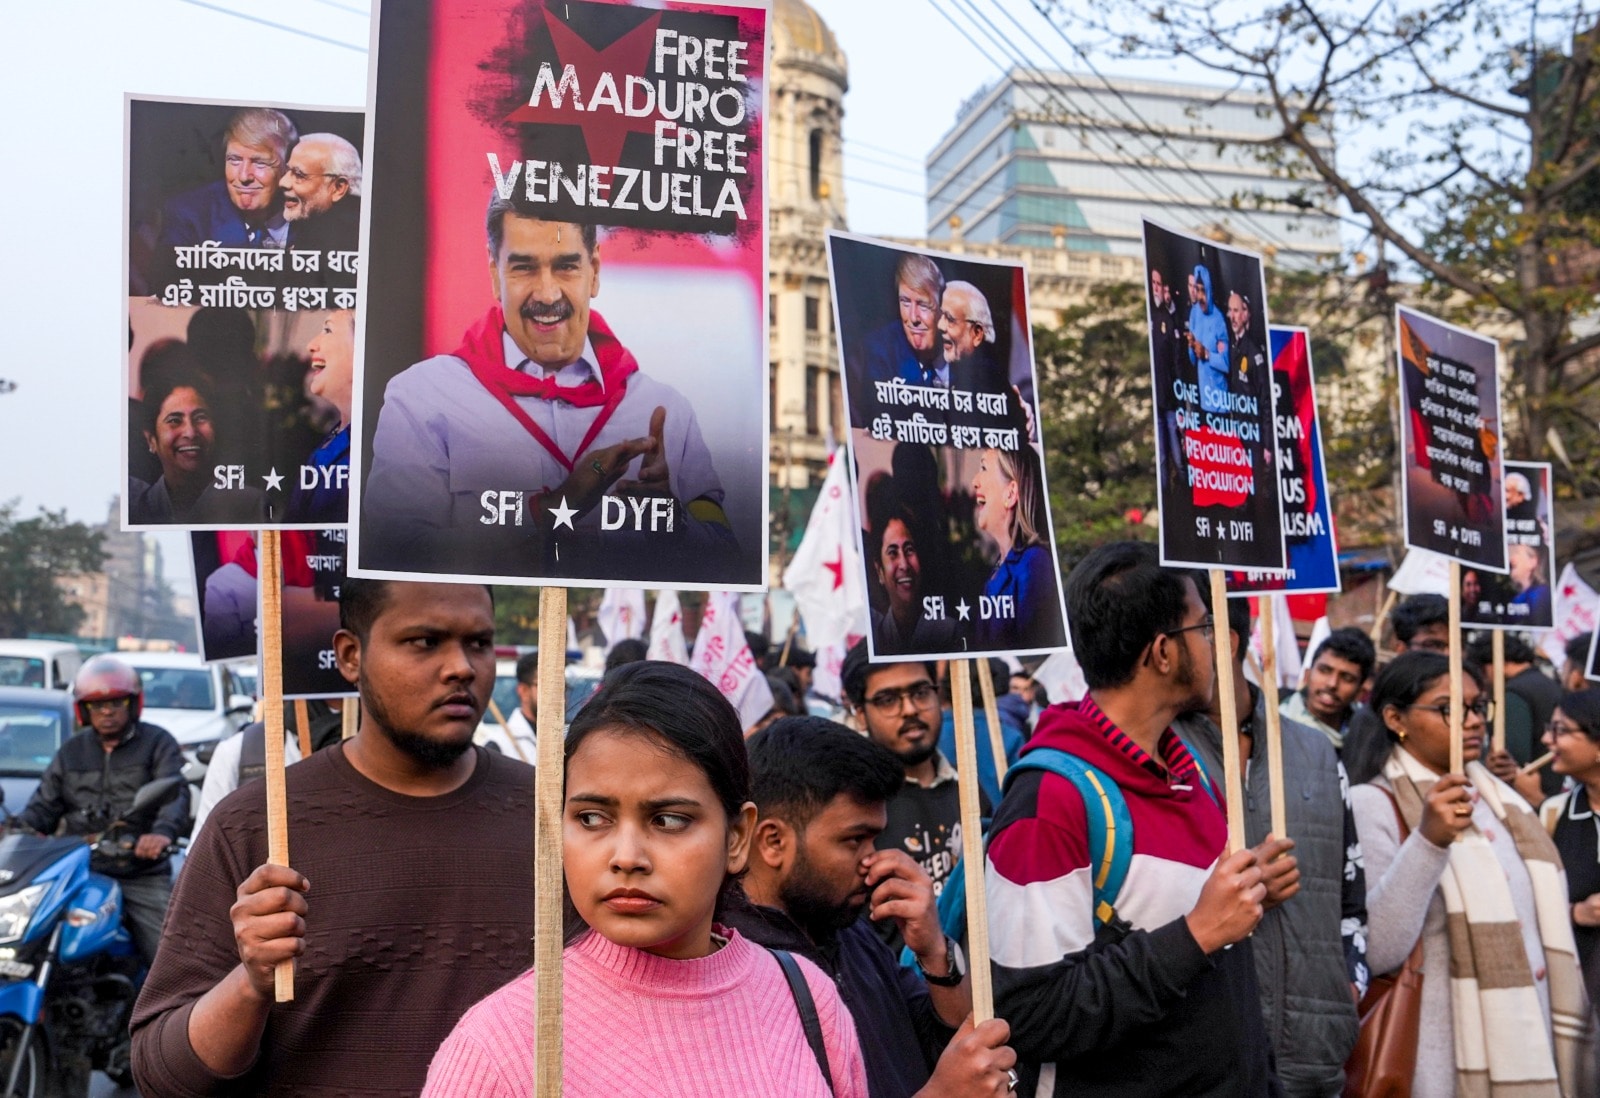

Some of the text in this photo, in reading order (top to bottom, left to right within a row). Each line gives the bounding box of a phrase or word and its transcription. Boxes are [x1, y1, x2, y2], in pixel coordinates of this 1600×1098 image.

[655, 28, 748, 82] FREE
[528, 61, 746, 127] MADURO
[654, 120, 747, 174] FREE
[486, 152, 747, 220] VENEZUELA
[174, 240, 285, 272] মার্কিনদের
[290, 250, 321, 273] চর
[162, 279, 194, 307] এই
[199, 276, 276, 308] মাটিতে
[282, 288, 328, 312] ধ্বংস
[874, 376, 1008, 416] মার্কিনদের চর ধরো
[1173, 378, 1258, 416] ONE SOLUTION
[871, 412, 1019, 451] এই মাটিতে ধ্বংস করো
[1175, 407, 1260, 442] ONE SOLUTION
[1185, 436, 1253, 468] REVOLUTION
[213, 464, 350, 490] SFI DYF
[1187, 465, 1255, 495] REVOLUTION
[480, 490, 674, 533] SFI DYFI
[1196, 517, 1254, 542] SFI DYFI
[922, 595, 1016, 620] SFI DYFI
